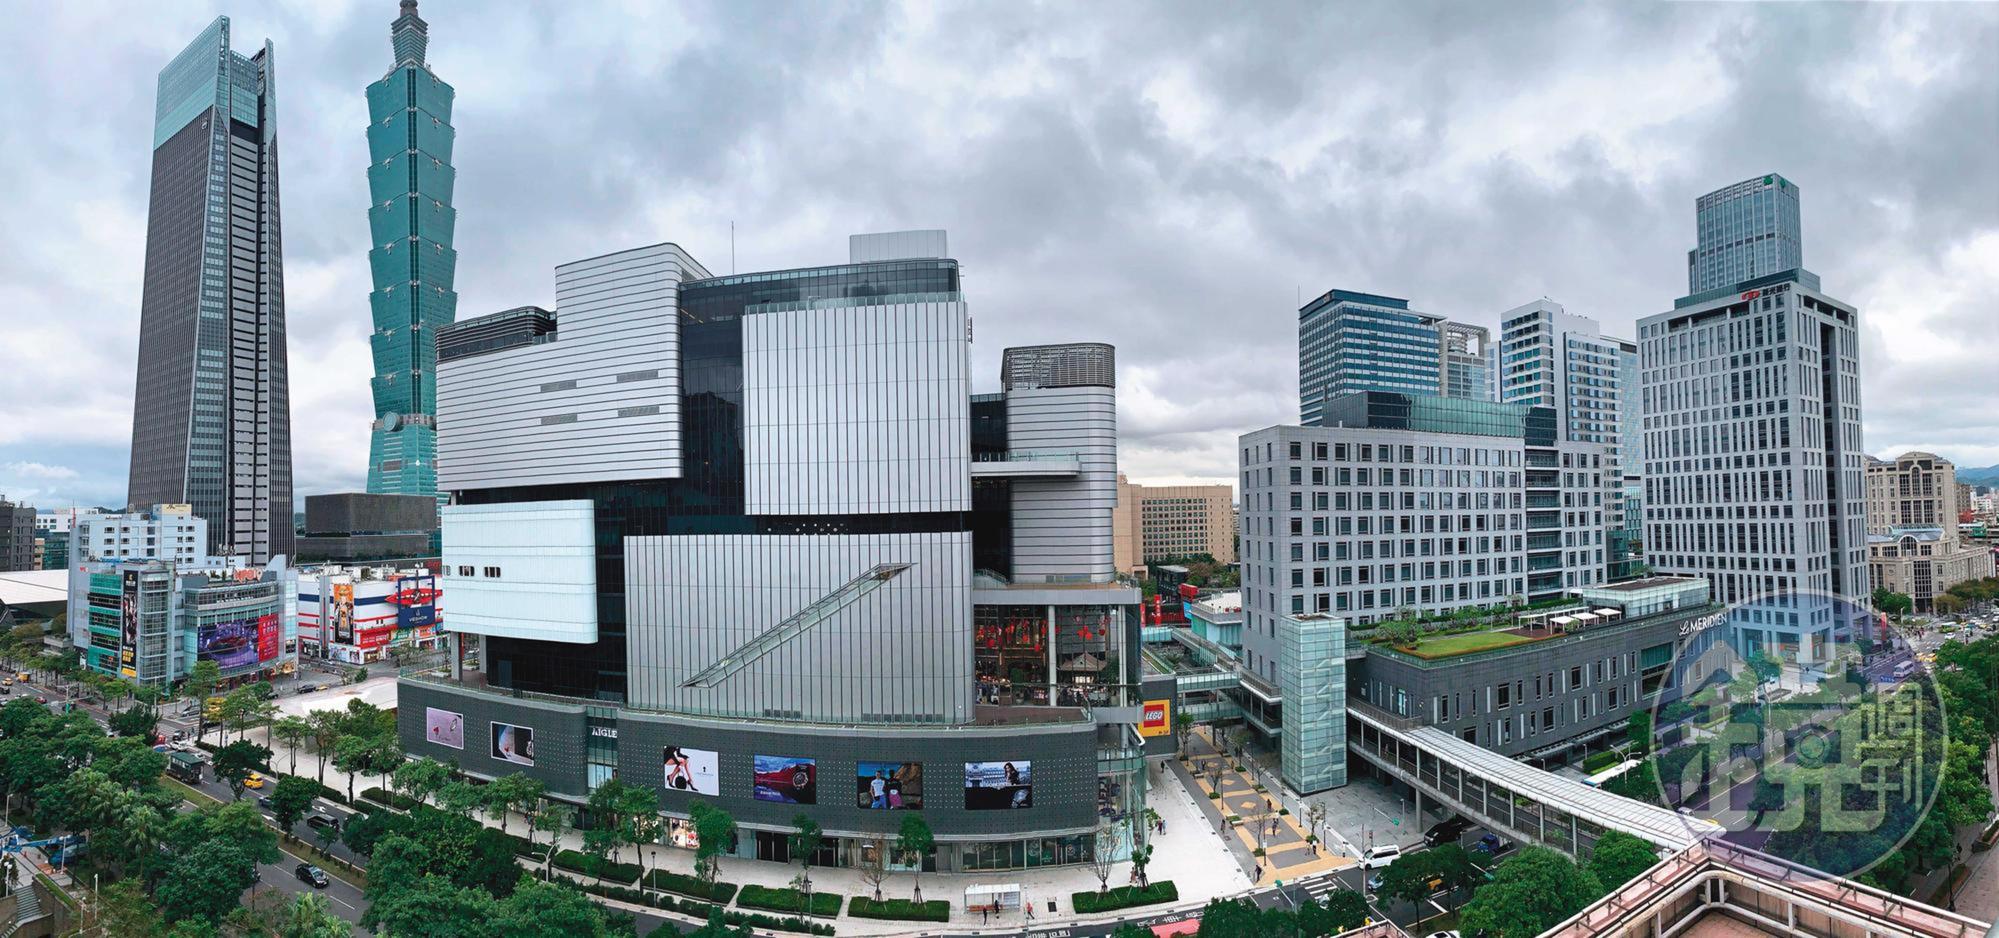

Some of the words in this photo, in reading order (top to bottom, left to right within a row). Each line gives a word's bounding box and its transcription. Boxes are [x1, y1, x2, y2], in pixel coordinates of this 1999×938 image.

[1678, 620, 1690, 636] Le
[1690, 612, 1728, 632] MERIDIEN
[1145, 711, 1164, 721] LEGO
[591, 727, 618, 739] AIGLE
